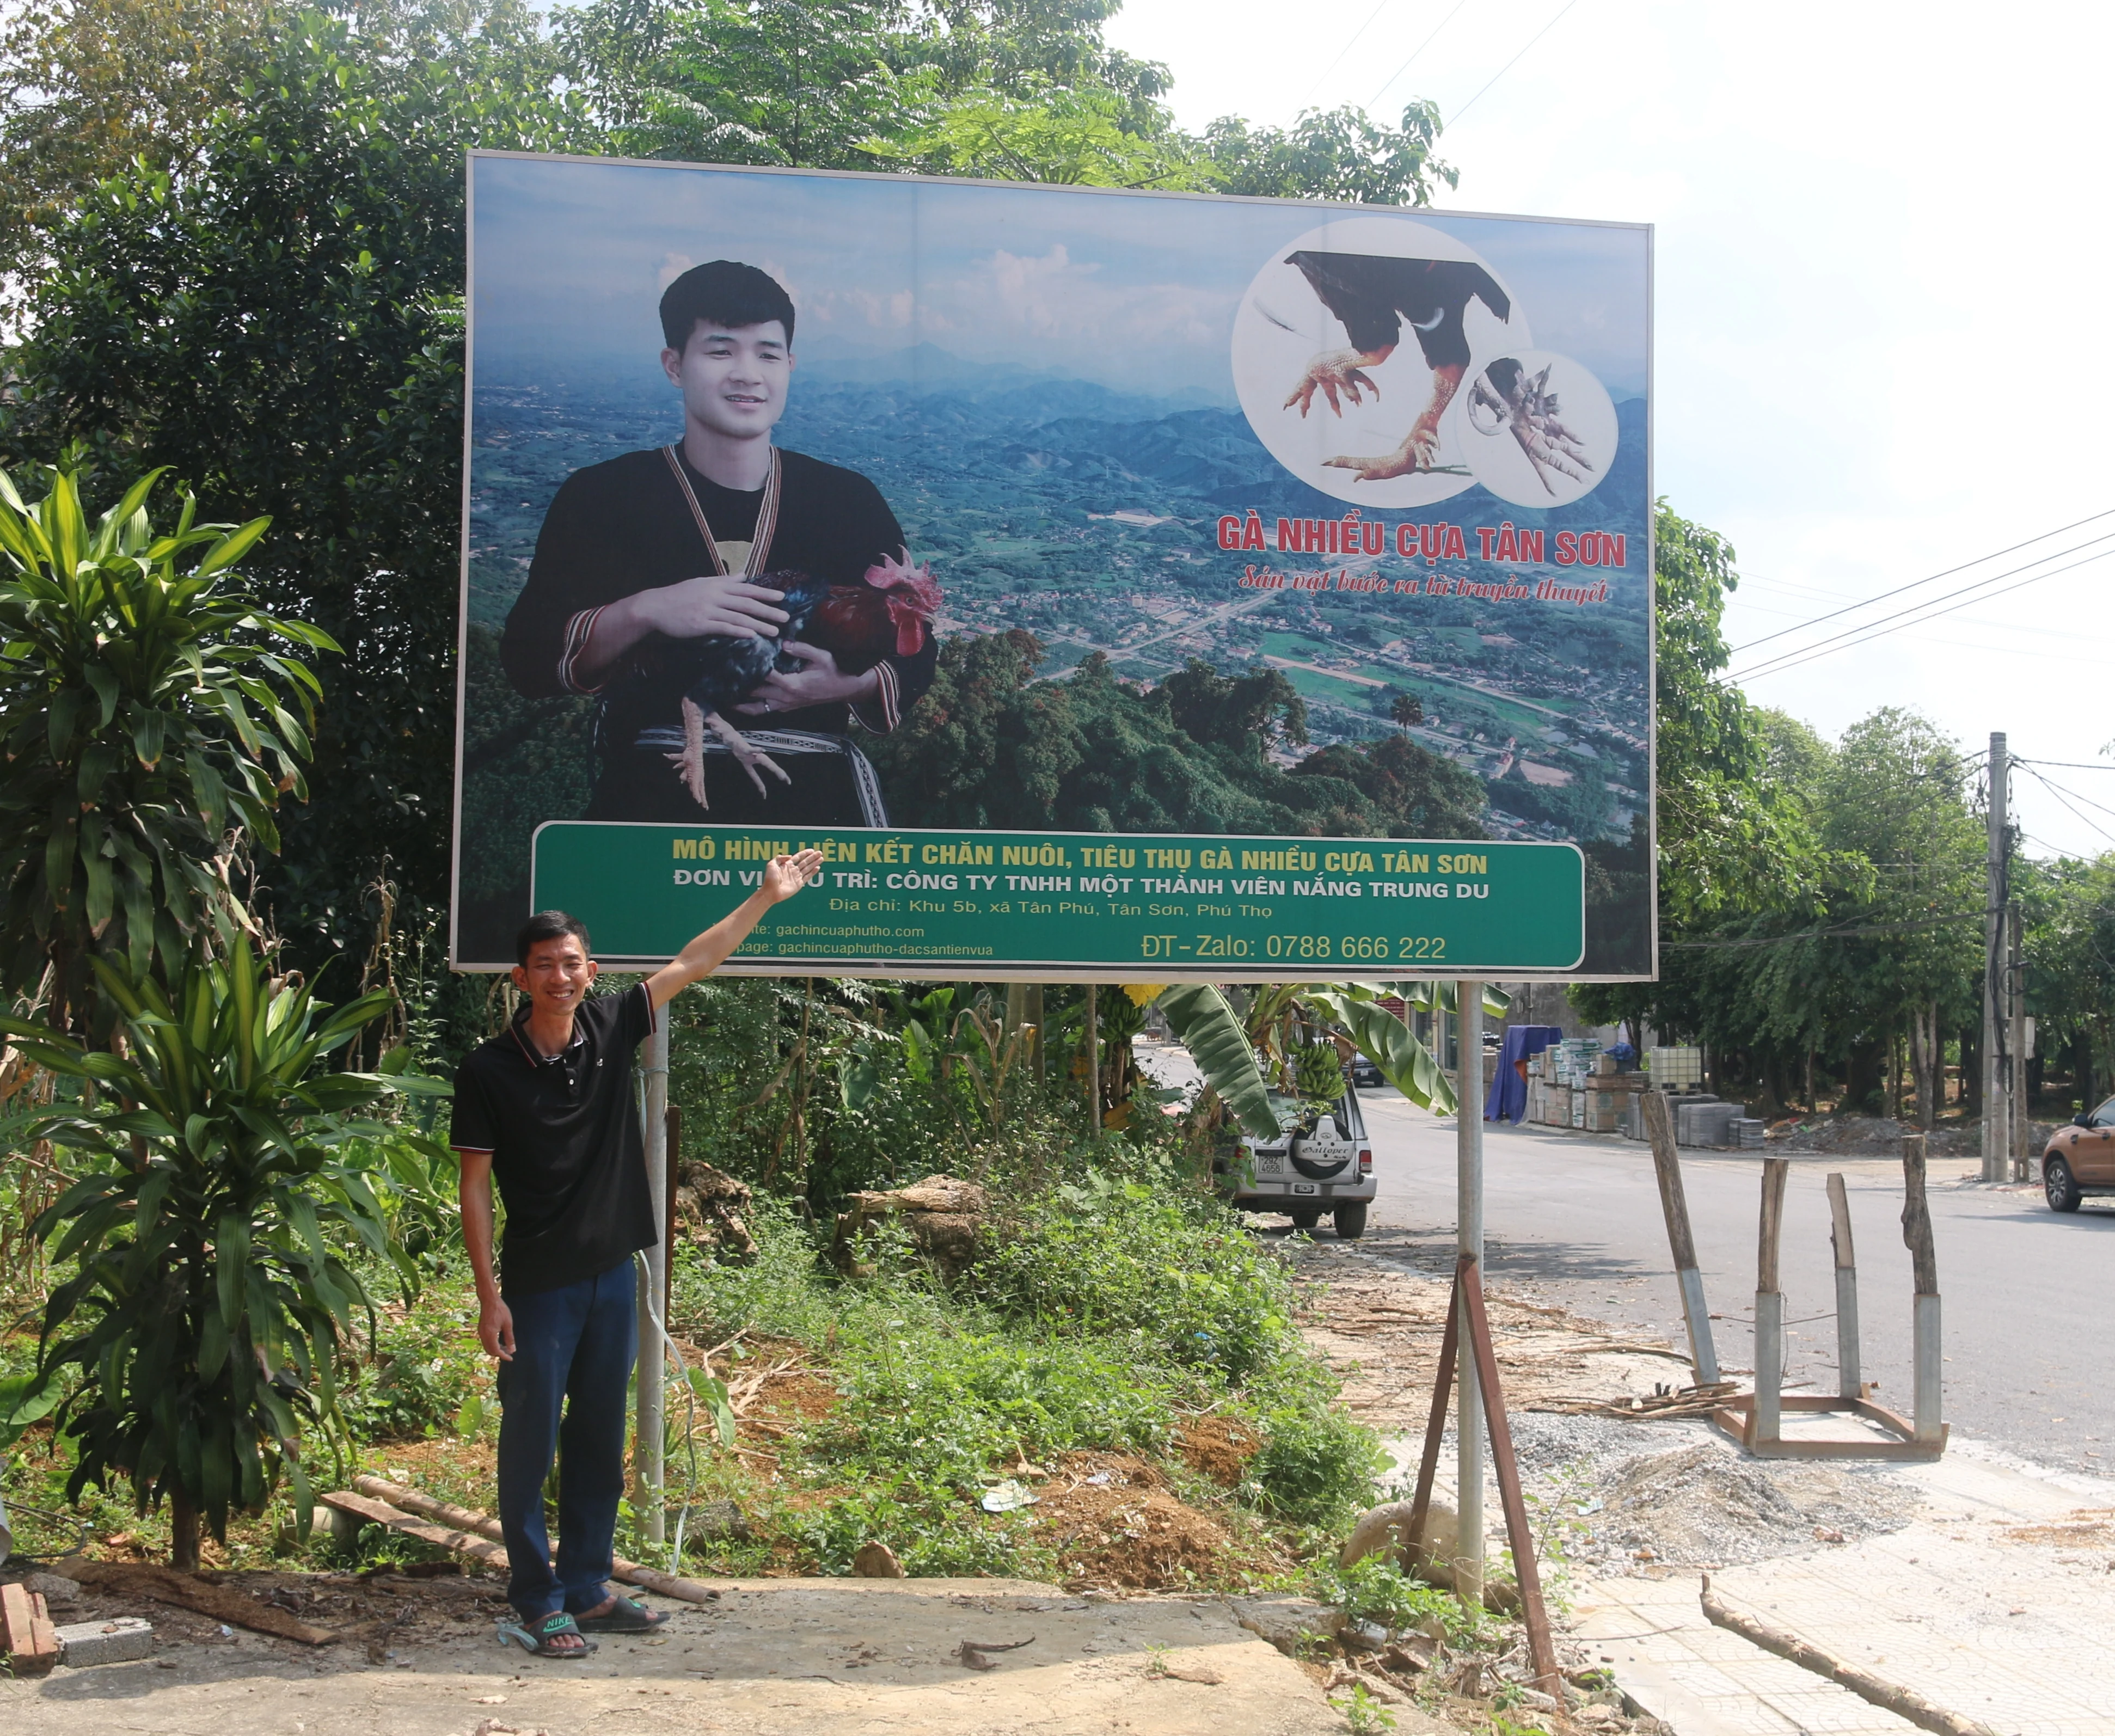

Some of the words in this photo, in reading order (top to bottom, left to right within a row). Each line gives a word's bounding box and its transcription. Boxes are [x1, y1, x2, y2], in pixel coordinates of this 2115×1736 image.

[1217, 508, 1266, 551] GÀ
[1277, 508, 1384, 556] NHIỀU
[1396, 522, 1467, 566] CỰA
[1476, 521, 1544, 563] TÂN
[1555, 530, 1626, 567] SƠN
[1238, 564, 1285, 589] Sản
[1292, 570, 1331, 597] vật
[1336, 568, 1389, 594] bước
[1394, 579, 1421, 595] ra
[1426, 574, 1452, 596] từ
[1456, 574, 1529, 603] truyền
[1536, 578, 1608, 606] thuyết
[673, 836, 715, 860] MÔ
[725, 836, 789, 861] HÌNH
[865, 837, 914, 864] KẾT
[922, 841, 993, 866] CHĂN
[1002, 842, 1072, 869] NUÔI,
[1080, 844, 1136, 869] TIÊU
[1143, 849, 1192, 873] THỤ
[1200, 846, 1234, 870] GÀ
[1241, 844, 1316, 872] NHIỀU
[1325, 851, 1375, 876] CỰA
[1381, 850, 1430, 874] TÂN
[1437, 853, 1487, 875] SƠN
[673, 869, 731, 886] ĐƠN
[738, 870, 763, 891] VỊ
[832, 869, 878, 889] TRÌ:
[886, 869, 958, 891] CÔNG
[965, 874, 998, 891] TY
[1004, 875, 1072, 892] TNHH
[1080, 874, 1134, 898] MỘT
[1140, 874, 1223, 894] THÀNH
[1230, 876, 1286, 896] VIÊN
[1293, 872, 1362, 898] NẮNG
[1369, 882, 1449, 899] TRUNG
[1456, 884, 1489, 899] DU
[829, 898, 860, 912] Địa
[868, 899, 901, 912] chỉ:
[910, 900, 946, 912] Khu
[953, 900, 982, 915] 5b,
[989, 901, 1010, 913] xã
[1017, 901, 1052, 913] Tân
[1059, 901, 1100, 917] Phú,
[1107, 903, 1141, 916] Tân
[1149, 904, 1190, 918] Sơn,
[1198, 904, 1232, 917] Phú
[1239, 905, 1272, 919] Thọ
[776, 924, 924, 938] gachincuaphutho.com
[778, 942, 994, 956] gachincuaphutho-dacsantienvua
[1267, 935, 1331, 958] 0788
[1341, 936, 1389, 959] 666
[1399, 937, 1446, 959] 222
[1264, 1156, 1278, 1164] 29Z
[547, 1616, 570, 1628] NIKE
